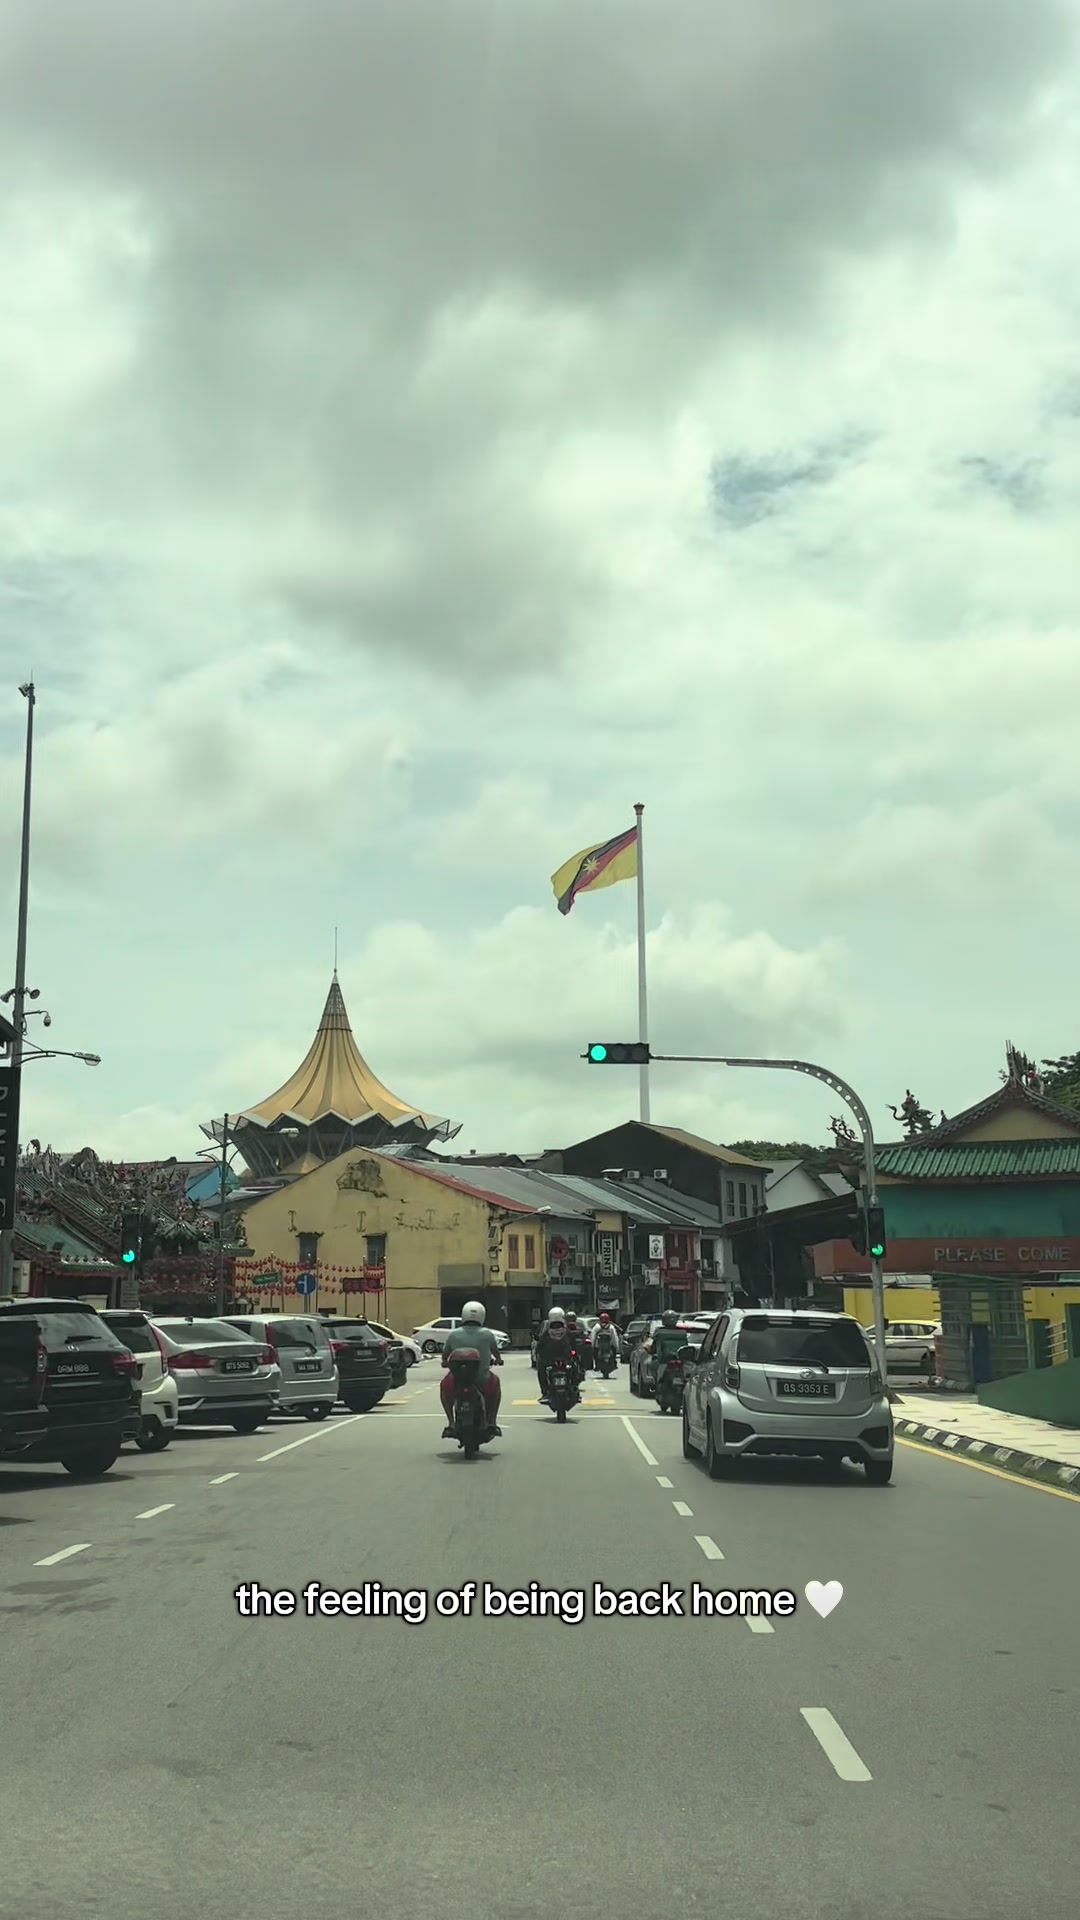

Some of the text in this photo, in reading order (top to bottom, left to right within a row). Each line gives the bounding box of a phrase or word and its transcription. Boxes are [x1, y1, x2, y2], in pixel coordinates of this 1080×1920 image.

[933, 1246, 1071, 1262] PLEASE COME
[783, 1383, 829, 1394] QS 3353 E
